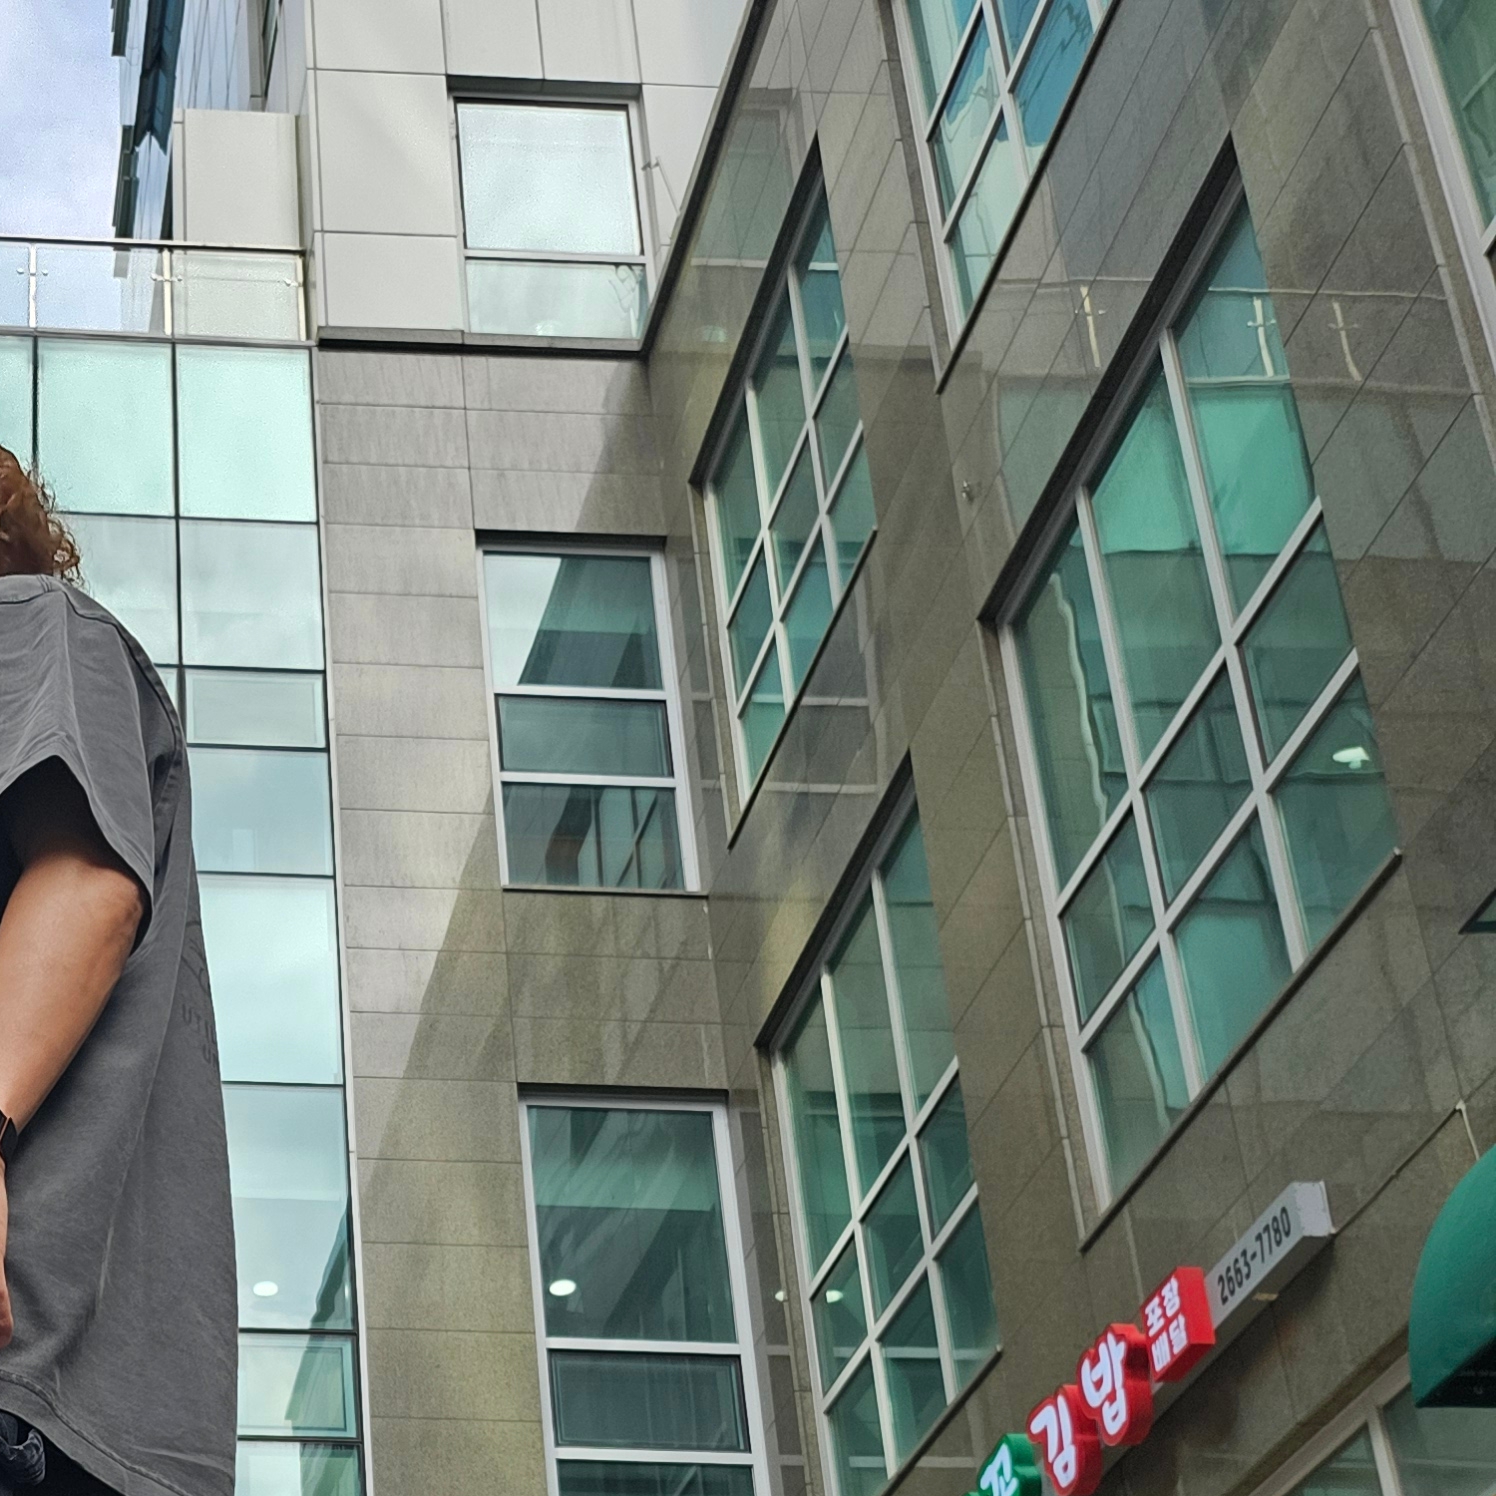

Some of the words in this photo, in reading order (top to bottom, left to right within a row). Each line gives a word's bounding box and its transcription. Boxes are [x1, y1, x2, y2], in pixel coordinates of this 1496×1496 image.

[1217, 1206, 1292, 1306] 2663-7780
[1144, 1275, 1181, 1338] 포장
[1151, 1312, 1188, 1373] 배달
